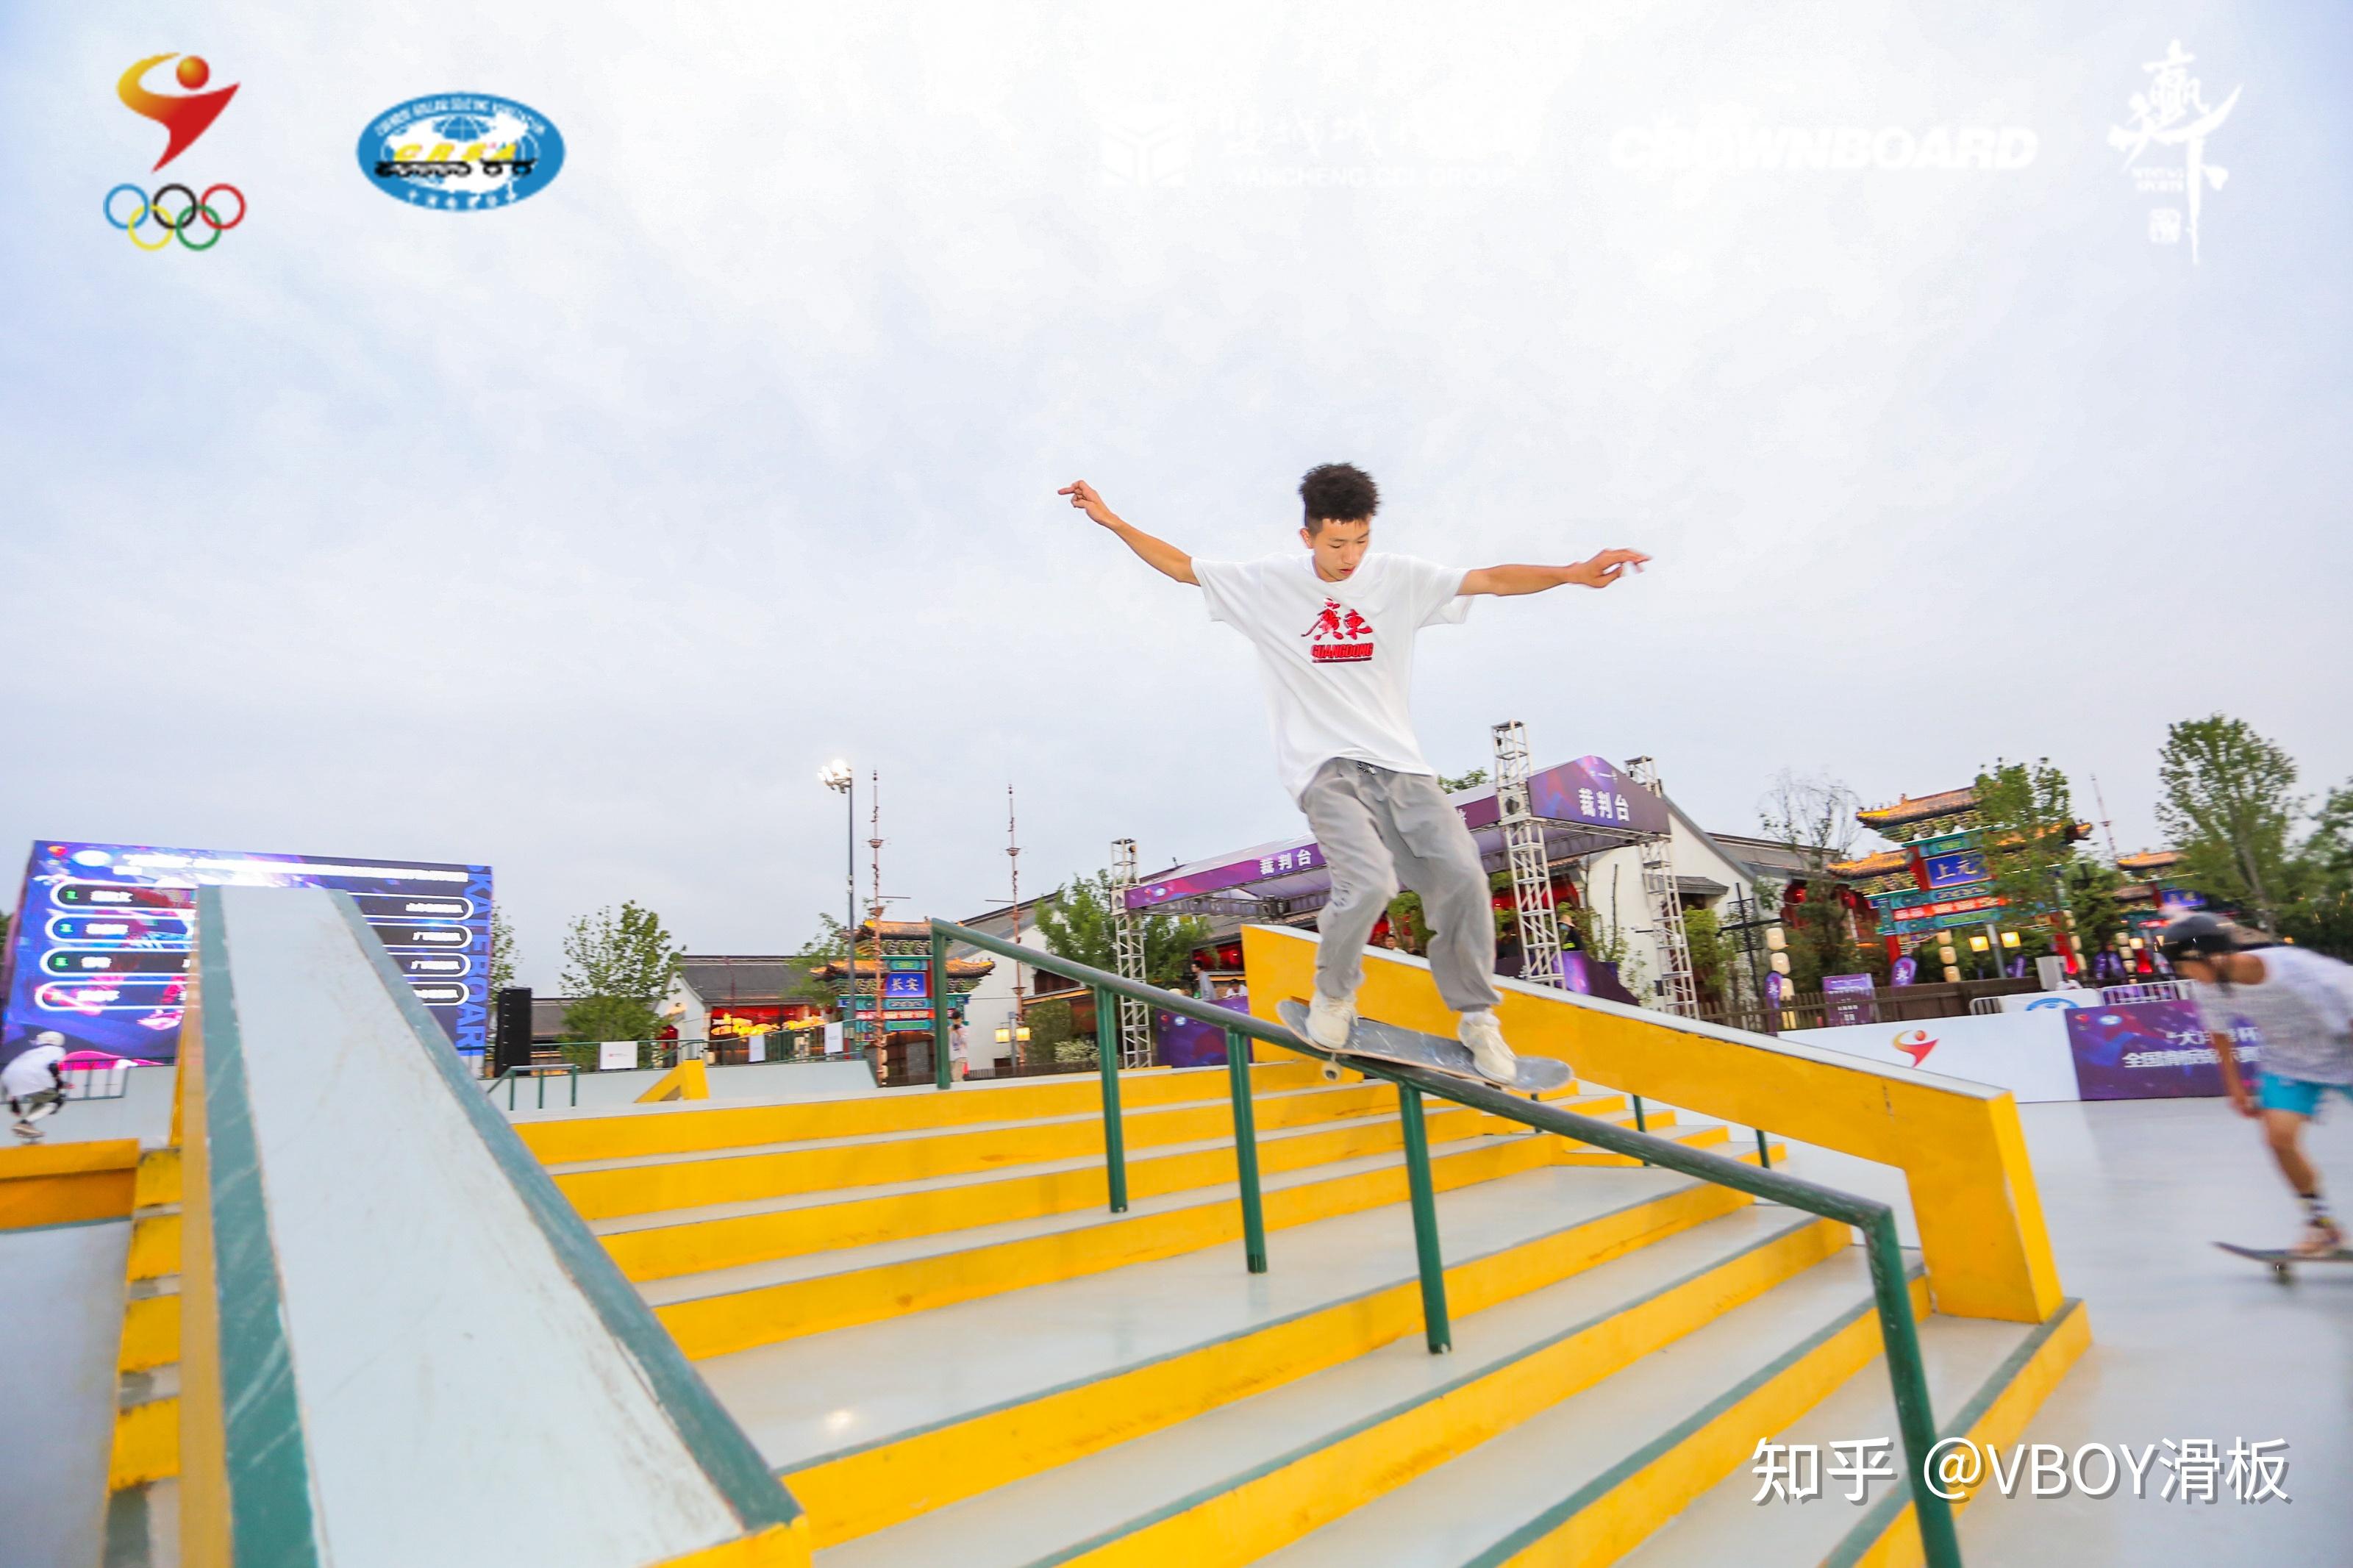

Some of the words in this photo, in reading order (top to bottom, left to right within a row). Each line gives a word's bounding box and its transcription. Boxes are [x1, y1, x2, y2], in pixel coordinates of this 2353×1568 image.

[1579, 787, 1629, 822] 裁判台
[1259, 848, 1312, 875] 裁判台
[1935, 859, 1978, 881] 上元
[891, 977, 919, 992] 长安
